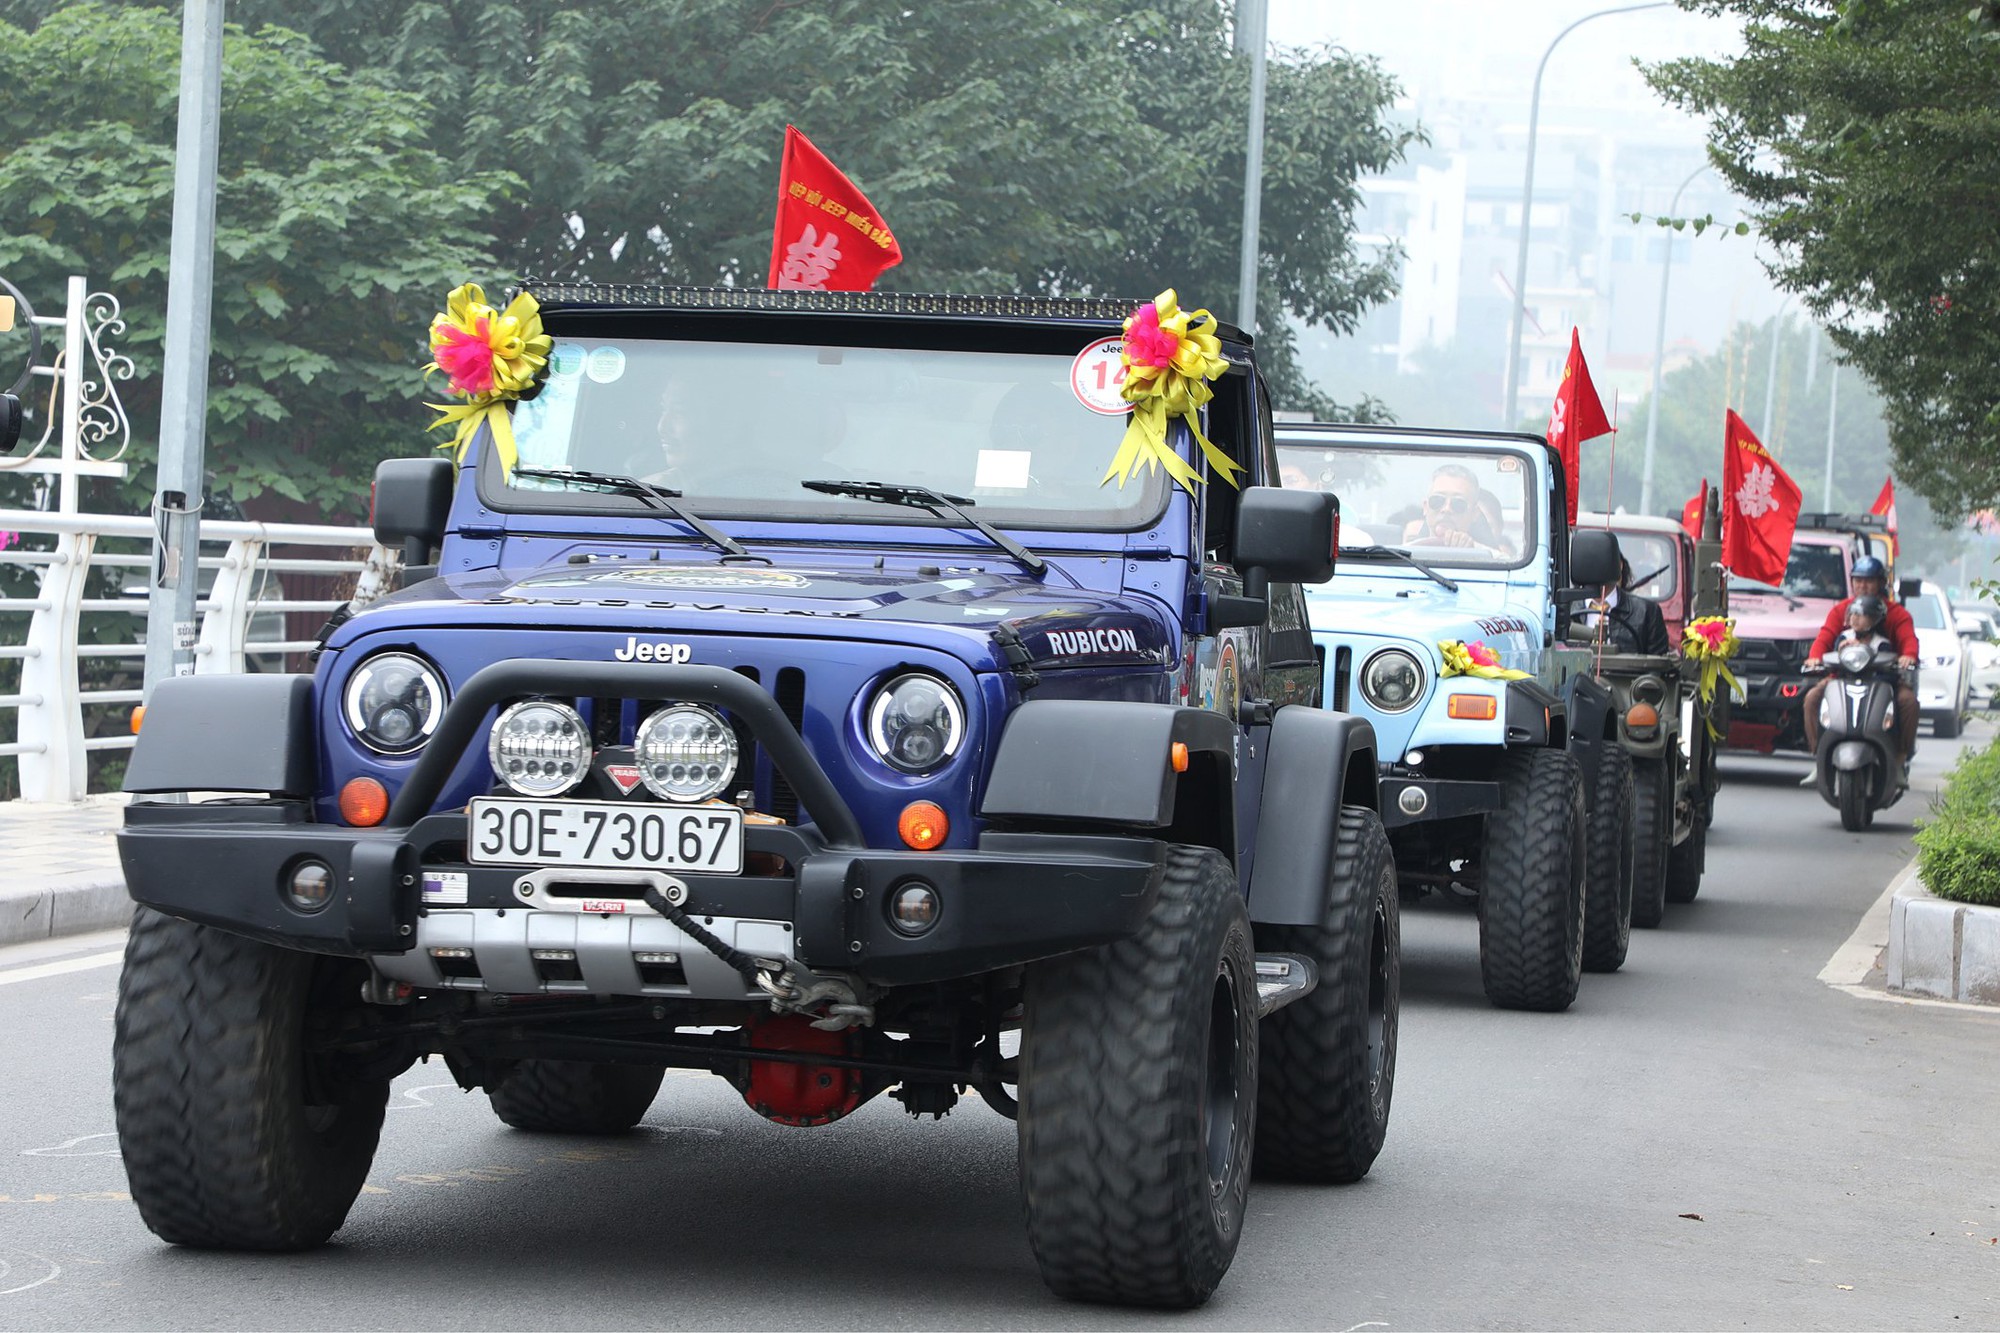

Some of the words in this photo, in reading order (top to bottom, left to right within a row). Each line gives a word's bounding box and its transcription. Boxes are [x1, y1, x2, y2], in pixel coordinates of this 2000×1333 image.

[1102, 344, 1123, 354] Jee
[614, 637, 691, 665] Jeep
[1045, 628, 1138, 656] RUBICON
[480, 807, 732, 866] 30E-730.67
[585, 902, 622, 911] WARN
